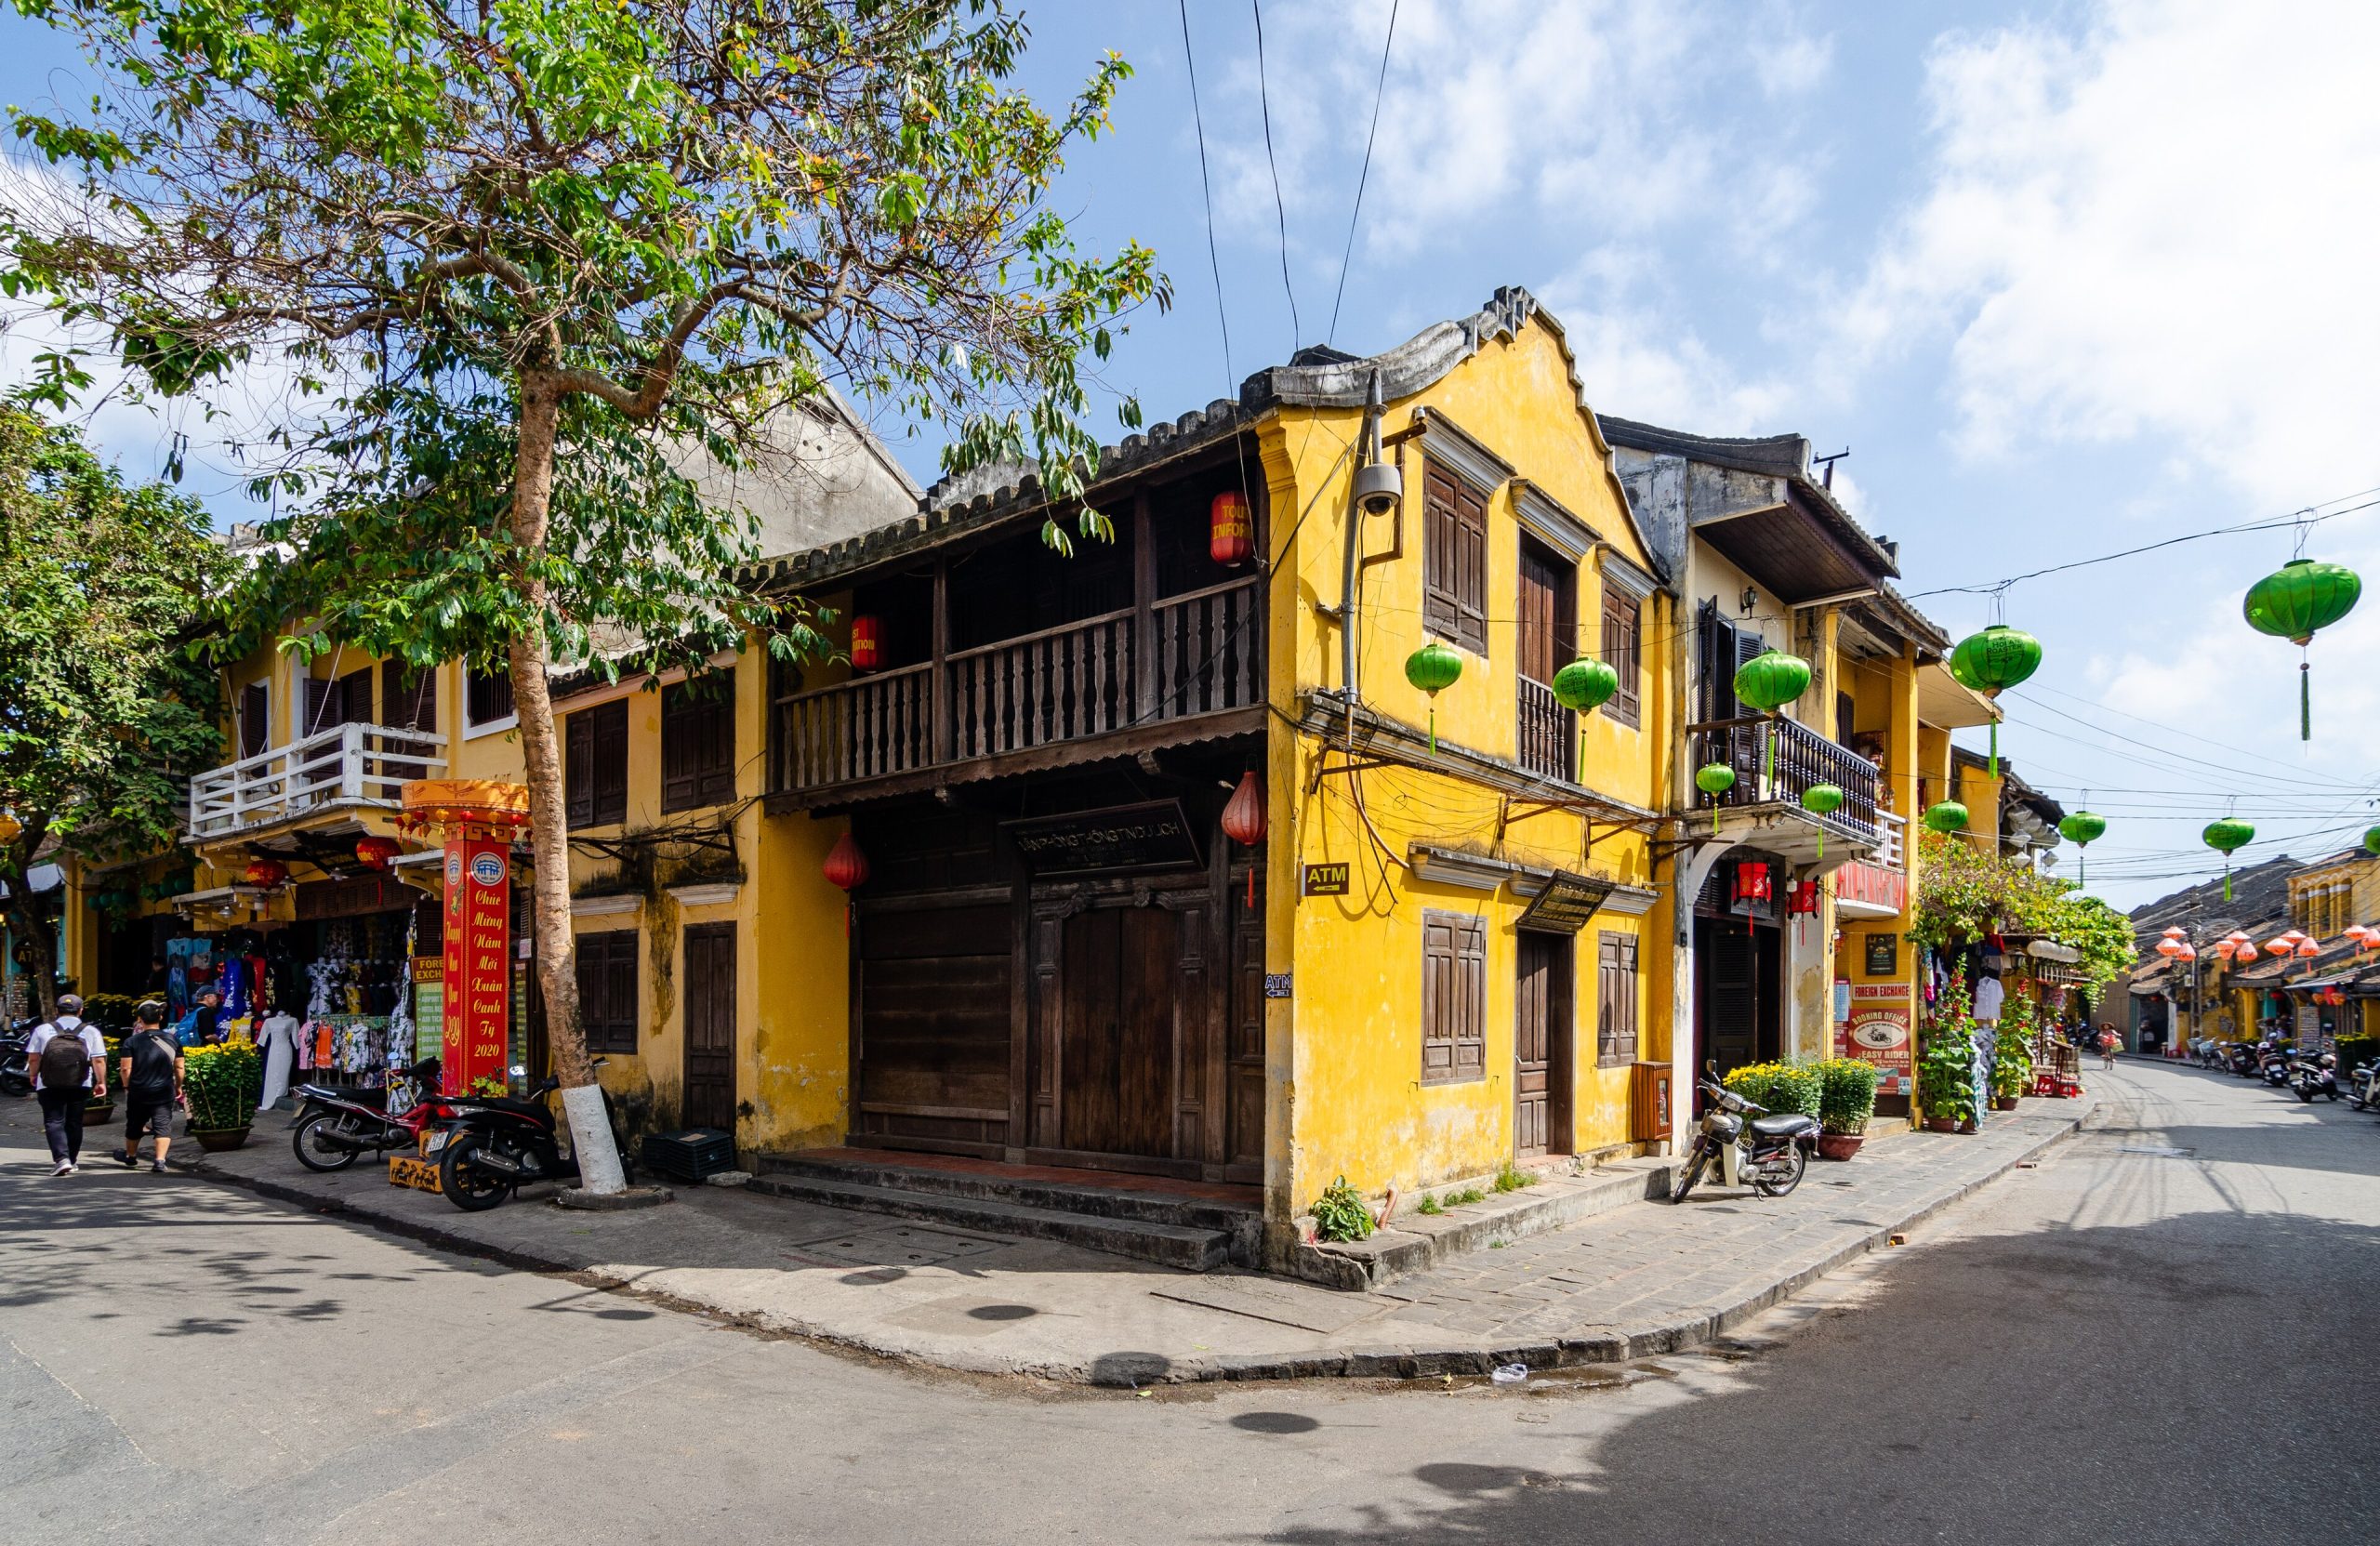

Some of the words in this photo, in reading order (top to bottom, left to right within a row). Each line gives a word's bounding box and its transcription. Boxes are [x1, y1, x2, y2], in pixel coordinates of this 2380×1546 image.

[1307, 867, 1346, 883] ATM
[475, 890, 501, 905] Chúc
[471, 911, 503, 931] Mừng
[474, 933, 501, 948] Năm
[476, 956, 498, 970] Mới
[416, 970, 443, 980] EXCH
[1265, 975, 1291, 989] ATM
[472, 976, 503, 992] Xuân
[1855, 986, 1878, 998] FOREIGN
[1880, 985, 1909, 998] EXCHANGE
[473, 998, 501, 1013] Canh
[1852, 1011, 1883, 1025] BOOKING
[1884, 1011, 1909, 1024] OFFICE
[474, 1043, 500, 1057] 2020
[1861, 1050, 1883, 1059] EASY
[1884, 1050, 1910, 1059] RIDER
